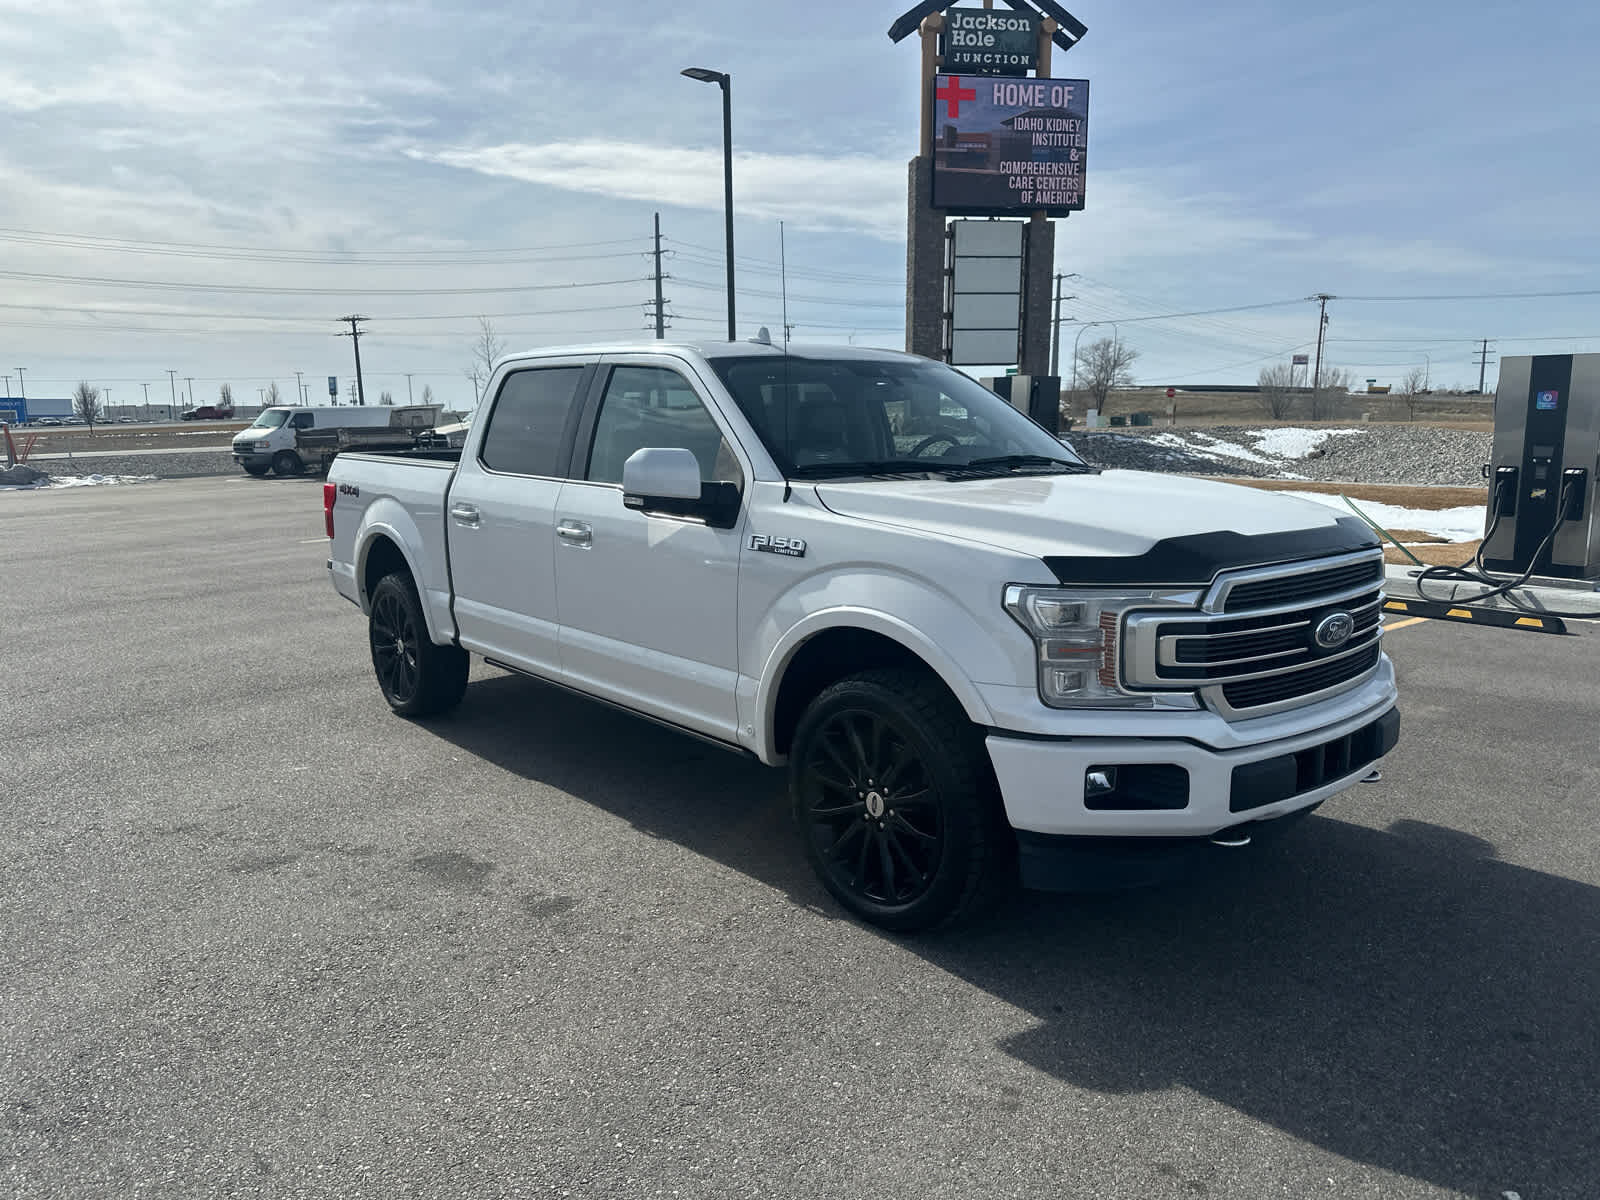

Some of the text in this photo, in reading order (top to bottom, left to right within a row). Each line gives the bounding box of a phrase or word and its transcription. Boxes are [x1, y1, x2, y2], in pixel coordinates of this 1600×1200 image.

[952, 13, 1031, 32] Jackson
[952, 30, 995, 46] Hole
[954, 53, 1029, 65] JUNCTION
[993, 83, 1074, 108] HOME OF
[1014, 117, 1081, 132] IDAHO KIDNEY
[1032, 132, 1081, 147] INSTITUTE
[1069, 148, 1080, 161] &
[1000, 161, 1080, 176] COMPREHENSIVE
[1009, 176, 1079, 190] CARE CENTERS
[1021, 190, 1078, 204] OF AMERICA
